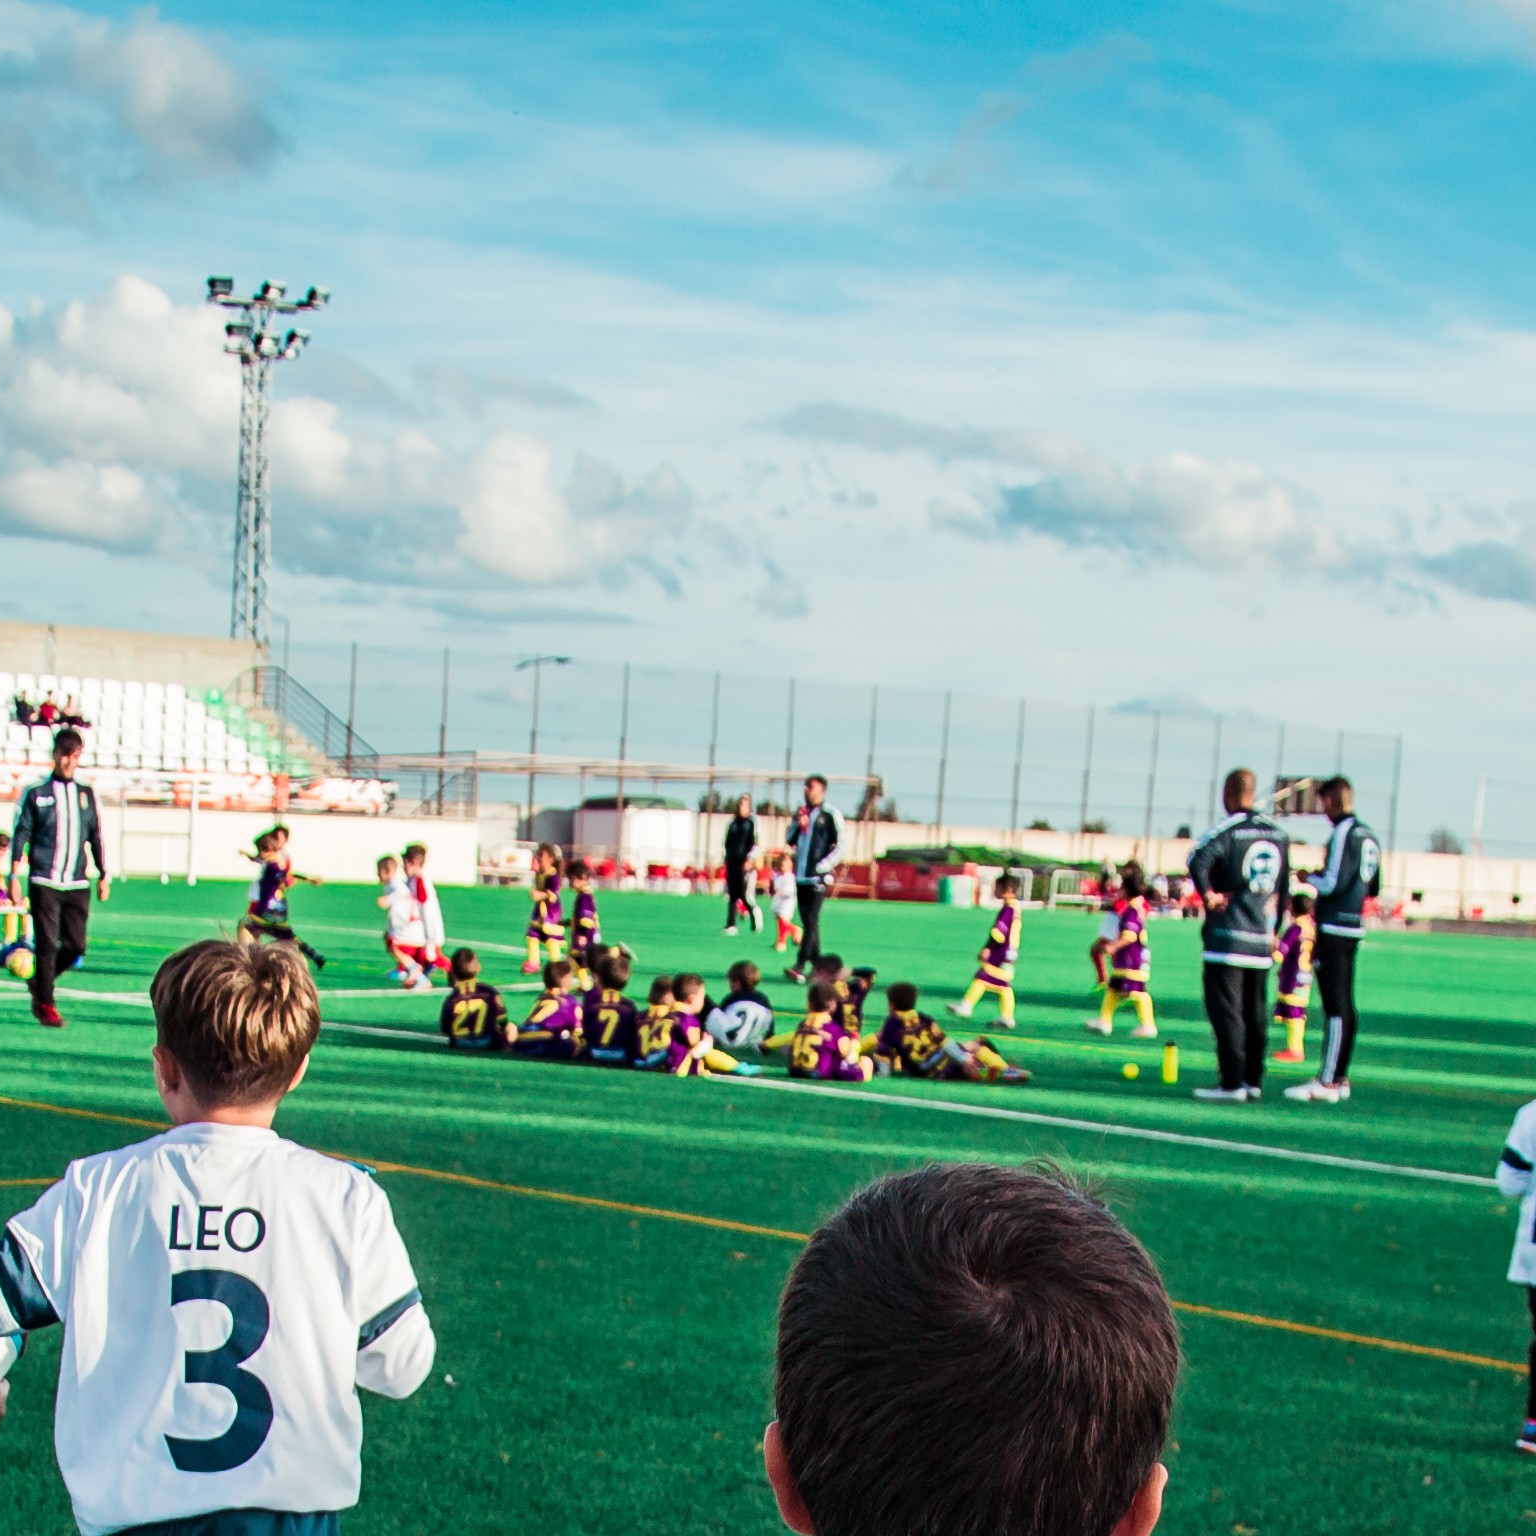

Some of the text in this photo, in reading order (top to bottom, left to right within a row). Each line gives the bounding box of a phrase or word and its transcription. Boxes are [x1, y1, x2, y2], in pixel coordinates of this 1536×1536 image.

[452, 998, 488, 1036] 27
[598, 1008, 619, 1046] 7
[168, 1204, 266, 1253] LEO
[163, 1267, 275, 1473] 3
